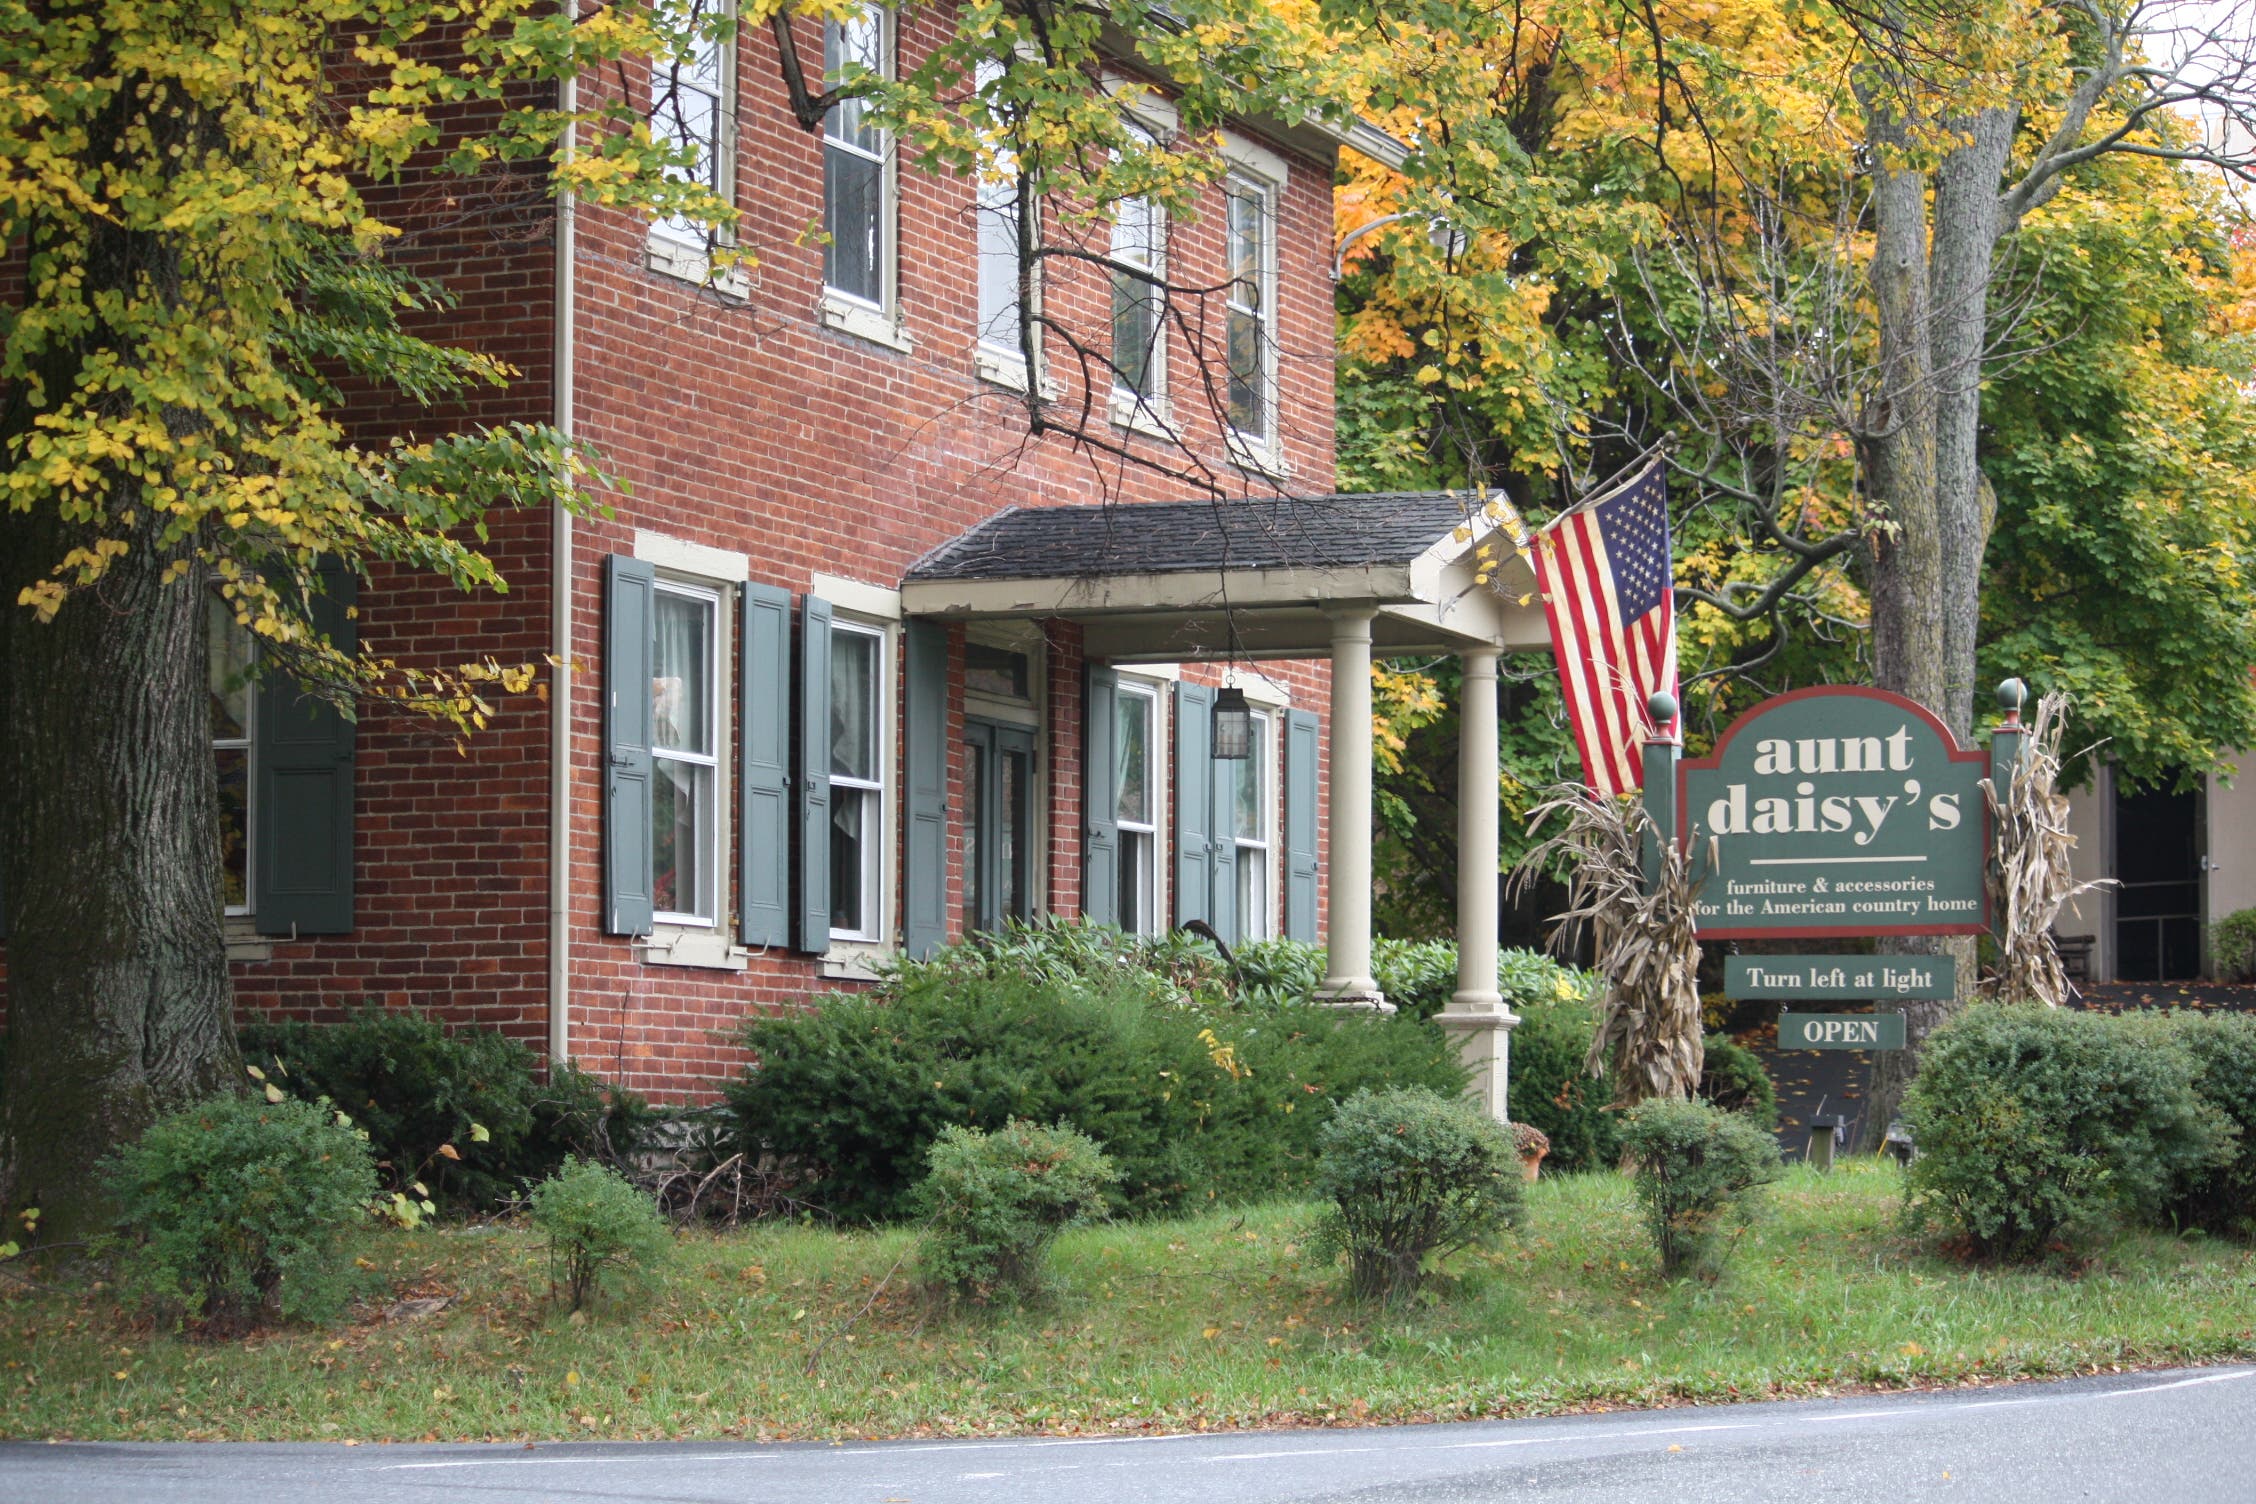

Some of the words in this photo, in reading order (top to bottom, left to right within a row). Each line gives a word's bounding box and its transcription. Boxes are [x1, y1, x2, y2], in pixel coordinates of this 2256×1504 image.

[1754, 724, 1914, 775] aunt
[1707, 779, 1961, 846] daisy's
[1727, 879, 1806, 895] furniture
[1813, 877, 1829, 893] &
[1835, 876, 1935, 892] accessories
[1727, 899, 1754, 915] the
[1760, 899, 1846, 915] American
[1853, 899, 1920, 916] country
[1928, 895, 1977, 911] home
[1746, 968, 1802, 988] Turn
[1810, 968, 1846, 988] left
[1854, 970, 1875, 988] at
[1882, 968, 1933, 993] light
[1803, 1020, 1879, 1043] OPEN
